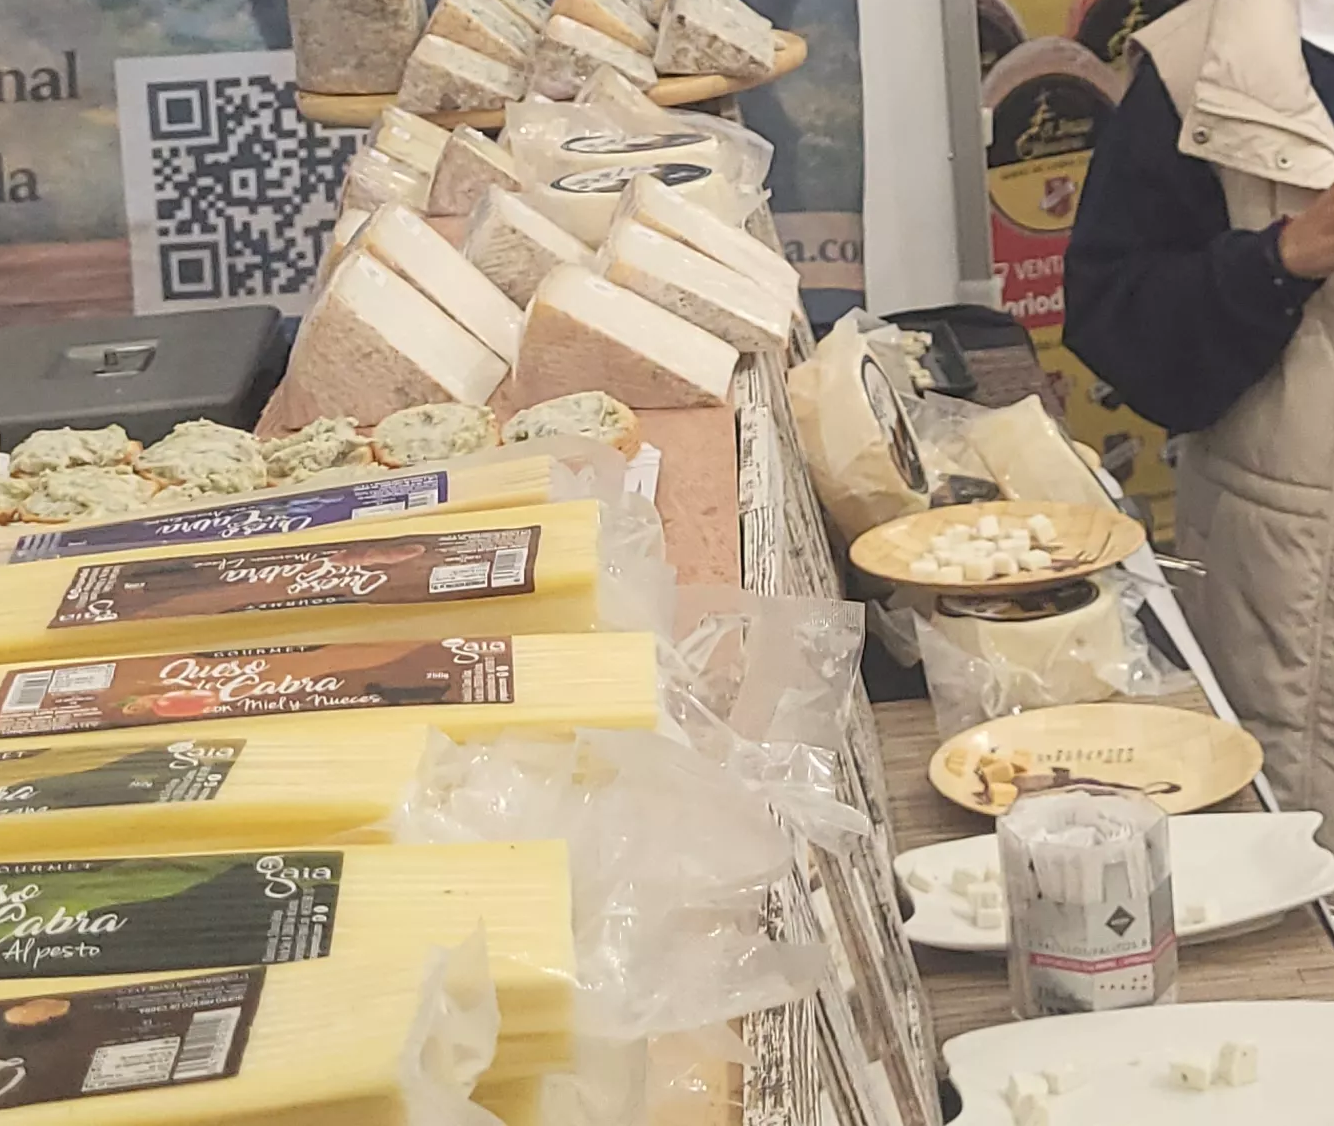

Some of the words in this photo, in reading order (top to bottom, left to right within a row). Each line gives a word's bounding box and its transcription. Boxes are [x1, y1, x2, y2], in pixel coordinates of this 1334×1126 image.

[159, 658, 271, 689] Queso
[219, 674, 346, 702] Cabra
[238, 696, 286, 712] Miel
